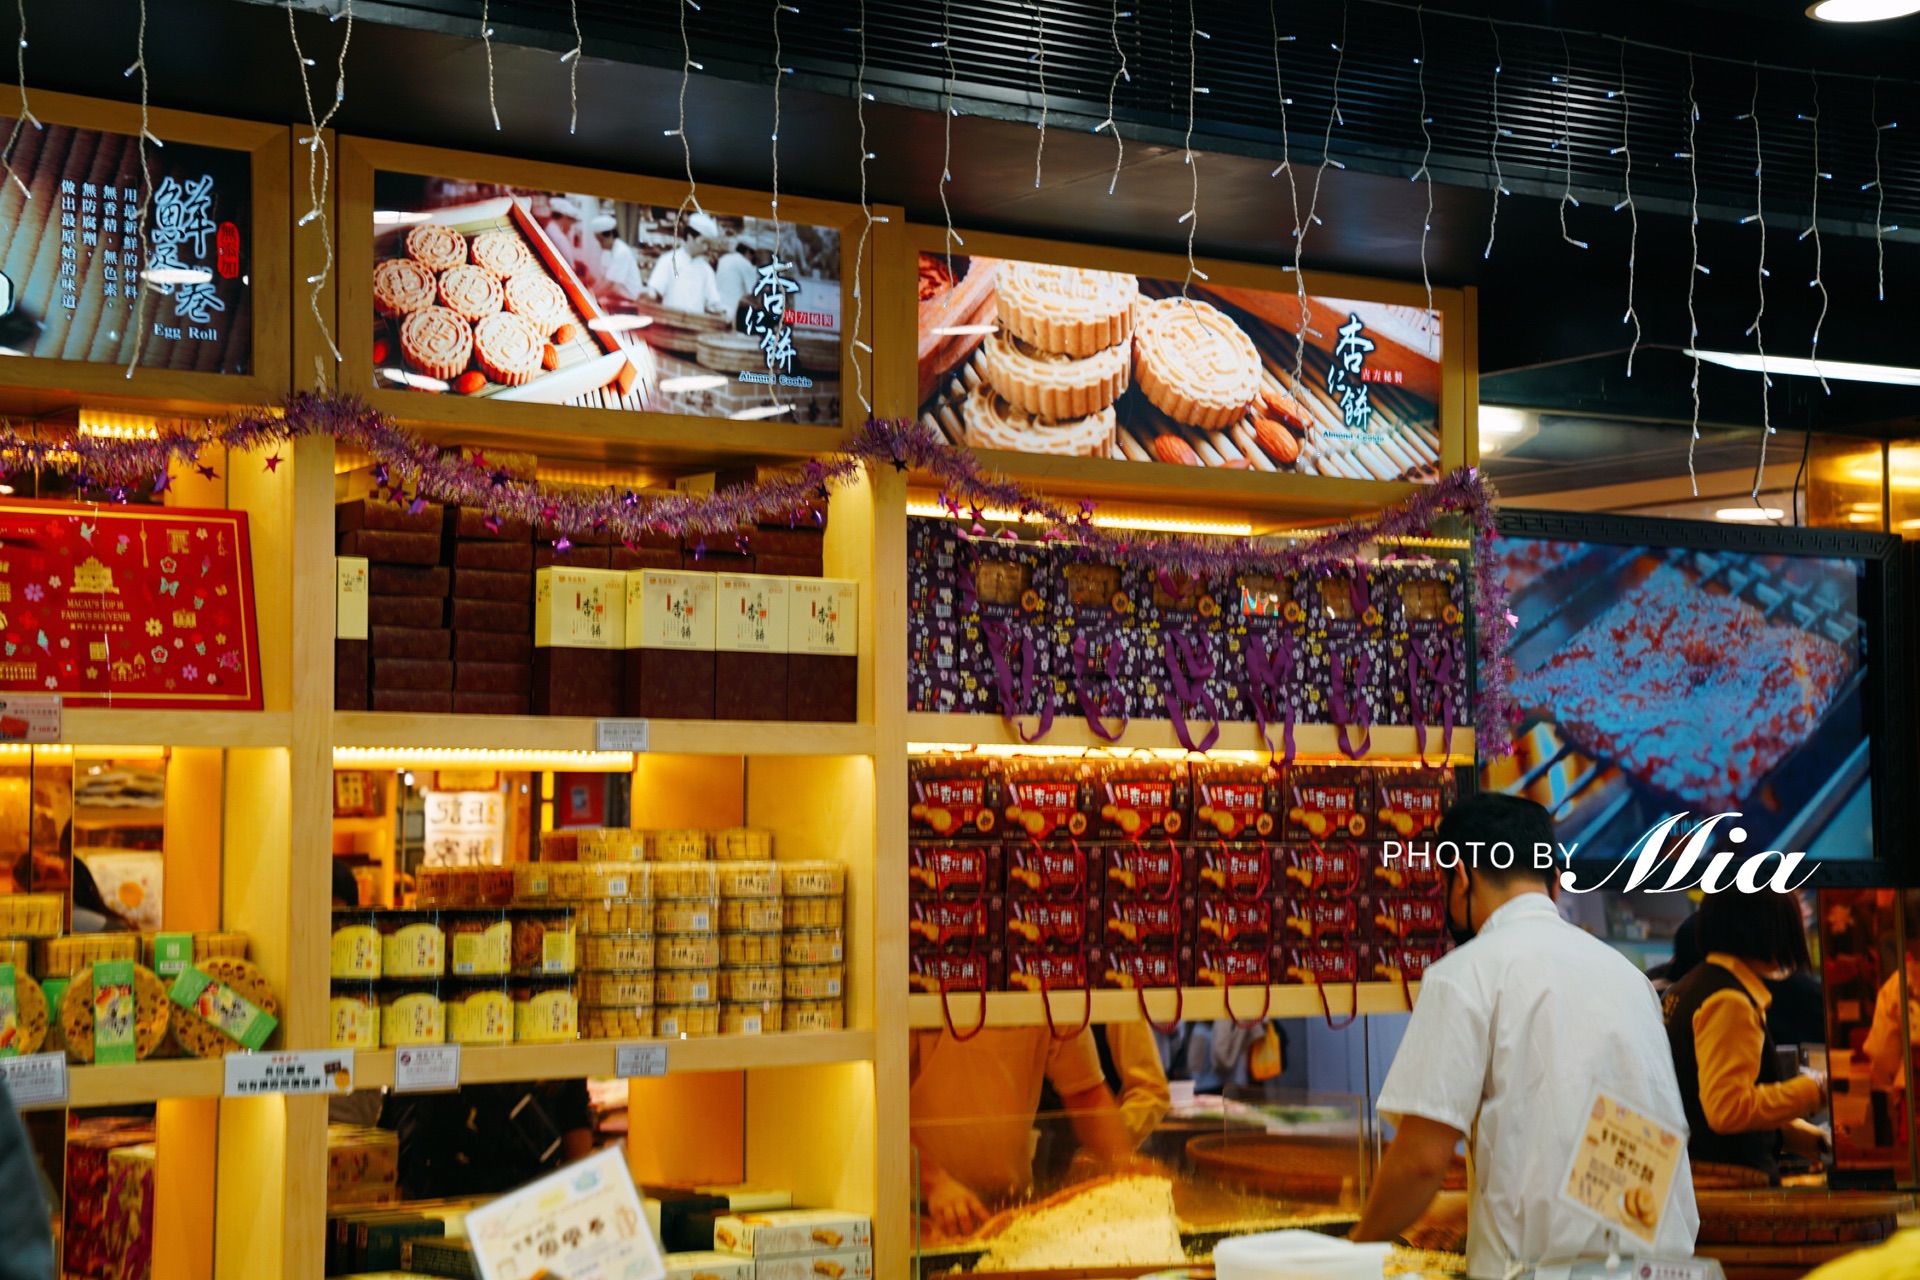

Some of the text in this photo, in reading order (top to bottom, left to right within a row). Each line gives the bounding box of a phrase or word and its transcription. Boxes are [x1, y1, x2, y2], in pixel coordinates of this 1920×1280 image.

[153, 323, 218, 341] Egg Roll
[1327, 313, 1375, 431] 杏仁餅
[61, 610, 131, 622] FAMOUS SOUVENIR
